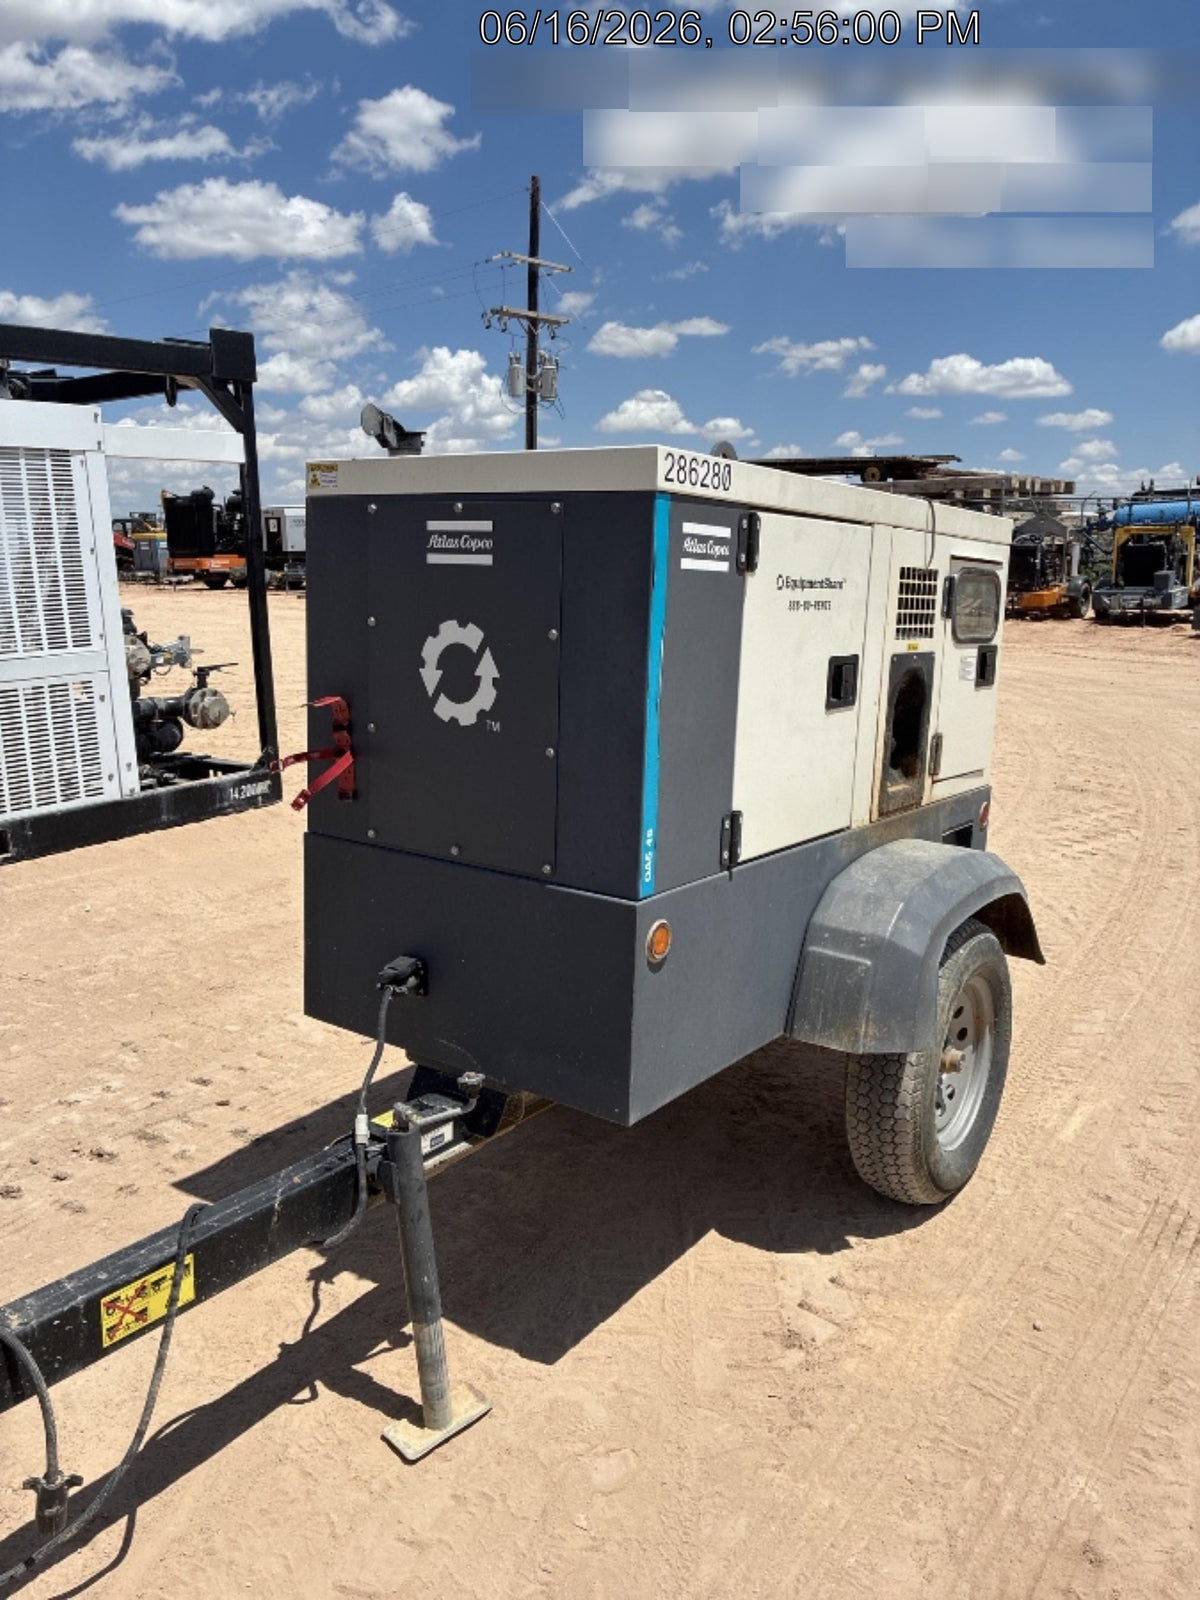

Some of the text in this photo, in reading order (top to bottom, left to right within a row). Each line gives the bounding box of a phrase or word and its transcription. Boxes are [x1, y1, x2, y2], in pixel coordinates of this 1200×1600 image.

[664, 452, 732, 491] 286280
[426, 534, 493, 552] Atlas Copco
[682, 536, 730, 559] Atlas Copco
